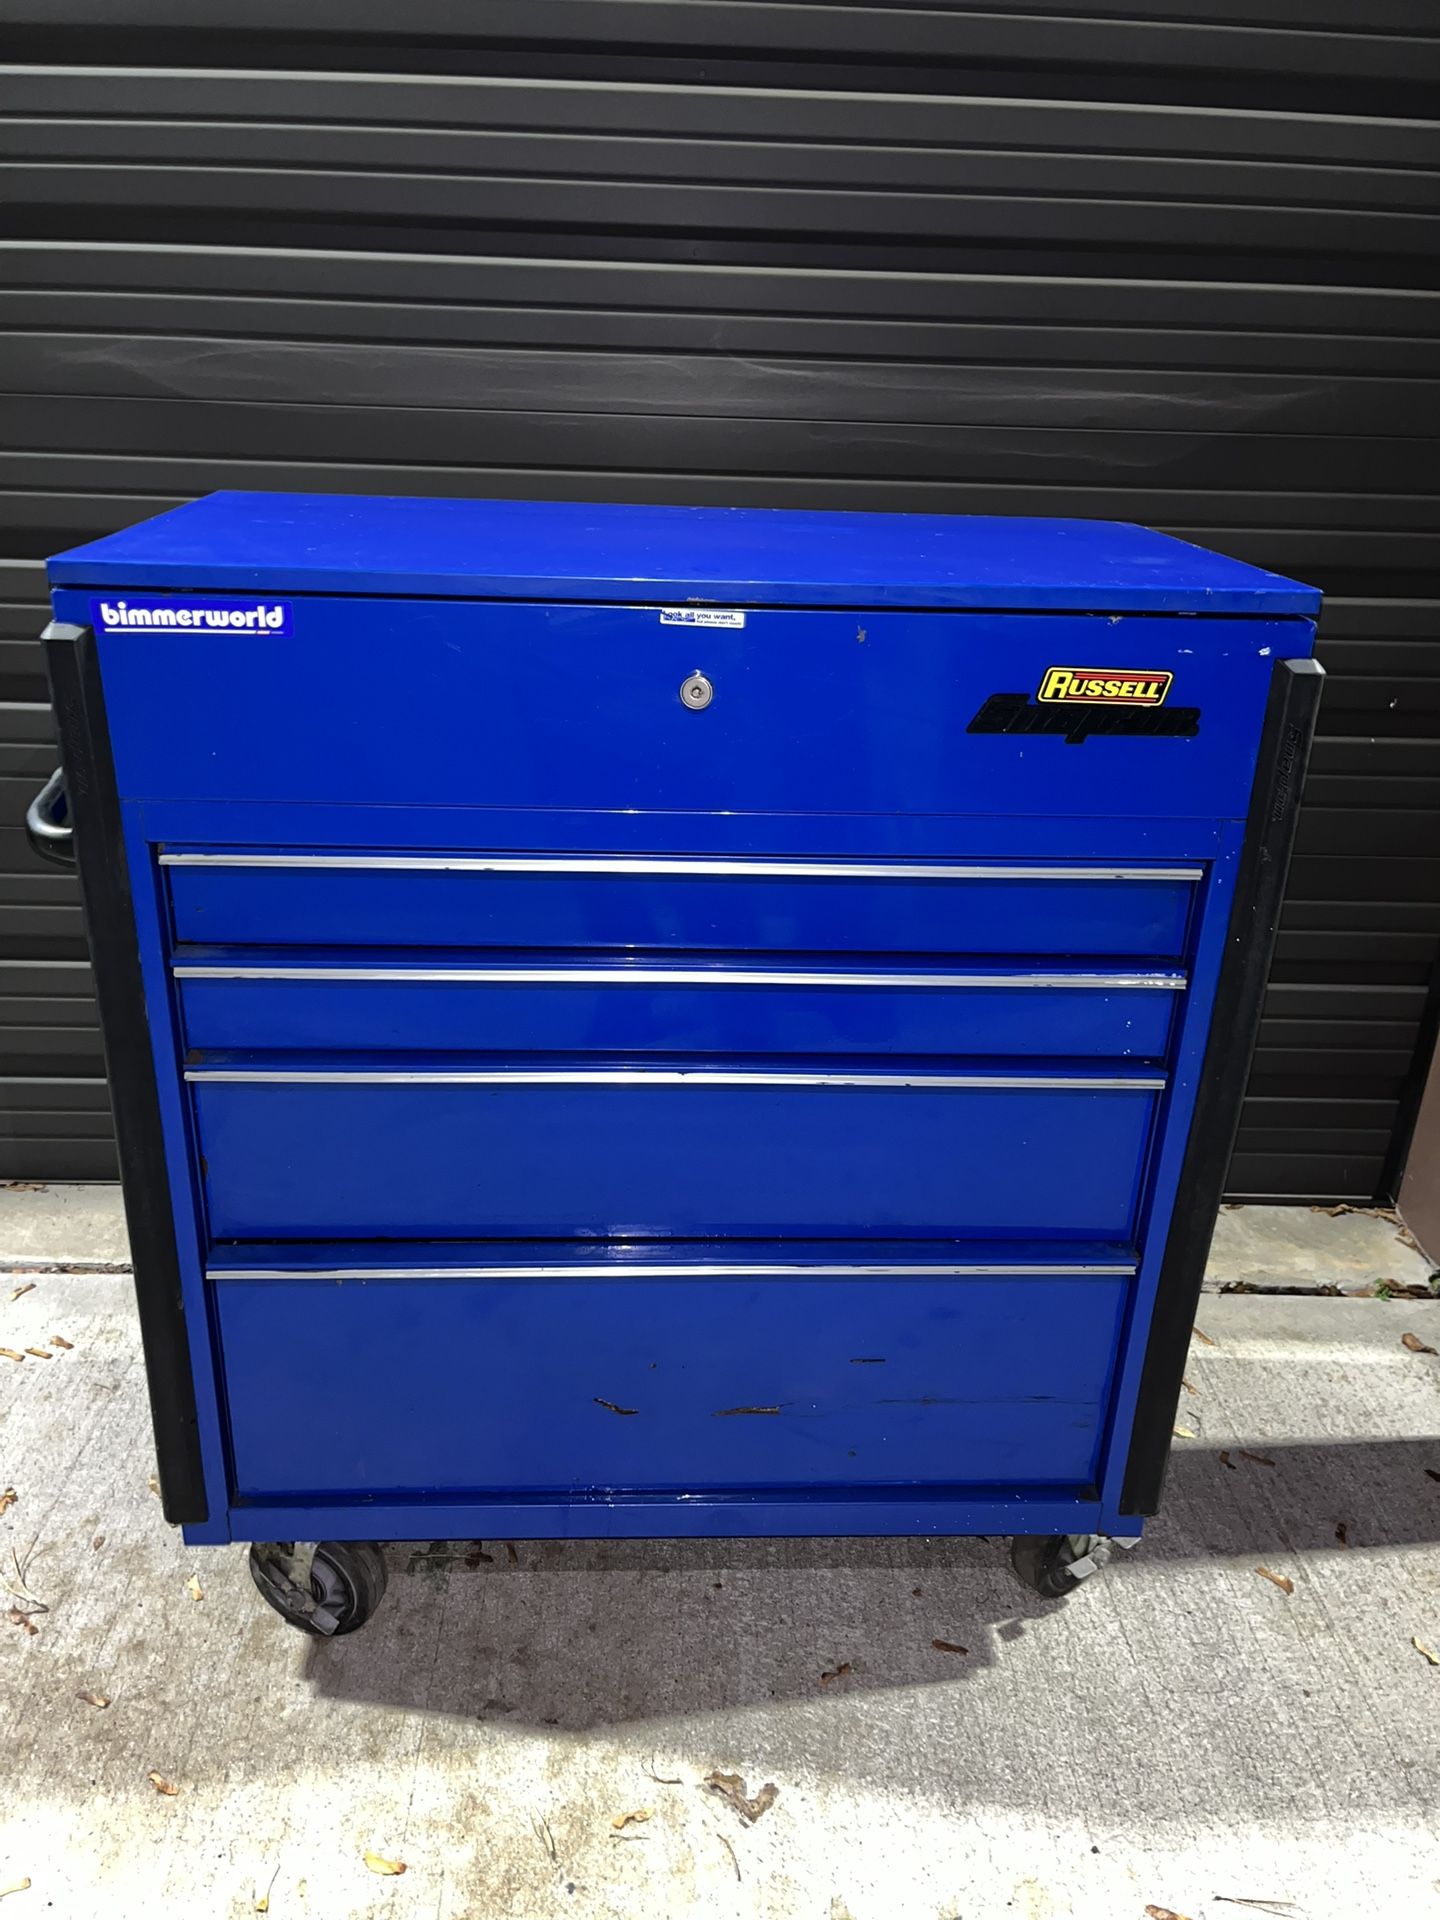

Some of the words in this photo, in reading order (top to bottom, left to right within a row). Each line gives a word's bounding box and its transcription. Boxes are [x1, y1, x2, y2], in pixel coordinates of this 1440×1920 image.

[100, 601, 284, 628] bimmerworld
[713, 613, 736, 621] want,
[1043, 671, 1160, 699] RUSSELL
